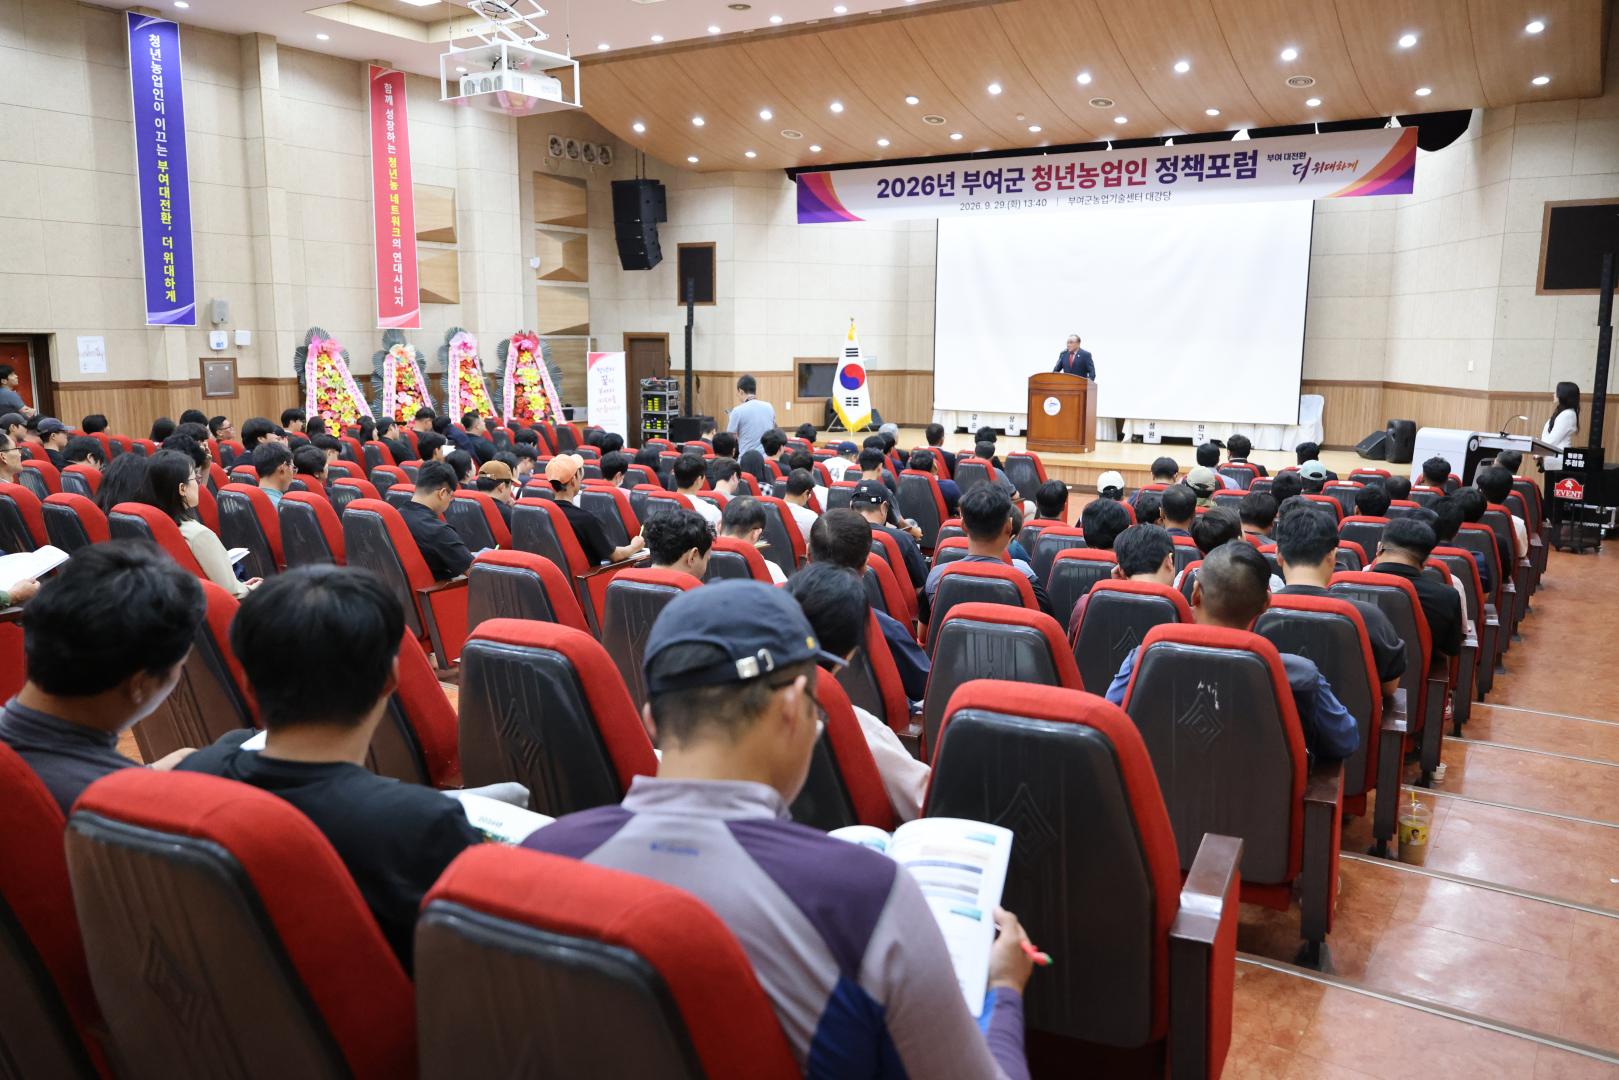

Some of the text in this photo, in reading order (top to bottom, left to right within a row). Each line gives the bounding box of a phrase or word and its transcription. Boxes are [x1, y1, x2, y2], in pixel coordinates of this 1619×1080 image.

[384, 83, 394, 106] 함께
[386, 109, 397, 155] 성장하는
[149, 33, 177, 303] 청년농업인이 이끄는 부여대전환, 더 위대하게
[876, 149, 1259, 199] 2026년 부여군 청년농업인 정책포럼
[1292, 156, 1359, 184] 더 위대하게
[1023, 198, 1048, 208] 13:40
[1068, 190, 1172, 206] 부여군농업기술센터 대강당
[393, 252, 404, 308] 연대시너지
[1556, 489, 1582, 498] EVENT
